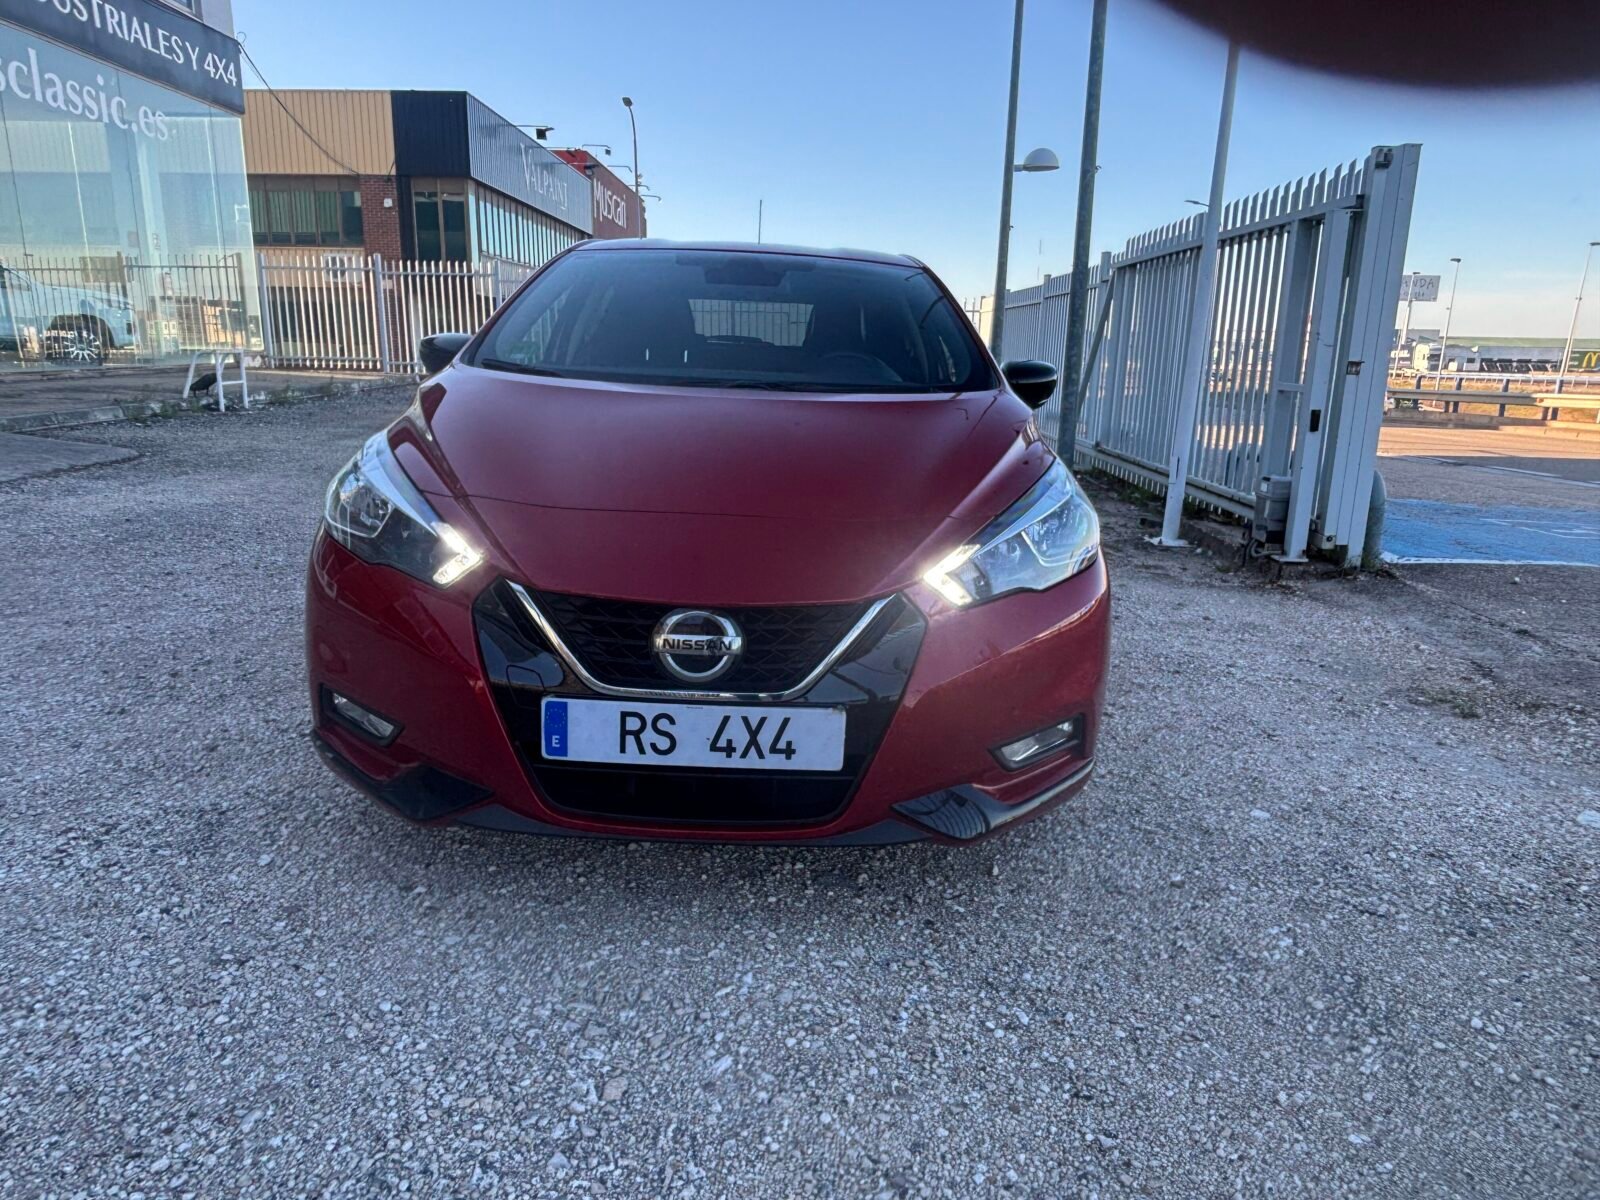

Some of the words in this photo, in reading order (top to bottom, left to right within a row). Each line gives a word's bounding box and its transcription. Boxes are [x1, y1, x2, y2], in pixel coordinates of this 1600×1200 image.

[40, 0, 184, 63] STRIALES
[186, 42, 199, 70] Y
[204, 53, 237, 86] 4X4
[662, 638, 732, 651] NISSAN
[551, 735, 560, 747] E
[619, 711, 677, 755] RS
[709, 715, 796, 760] 4X4
